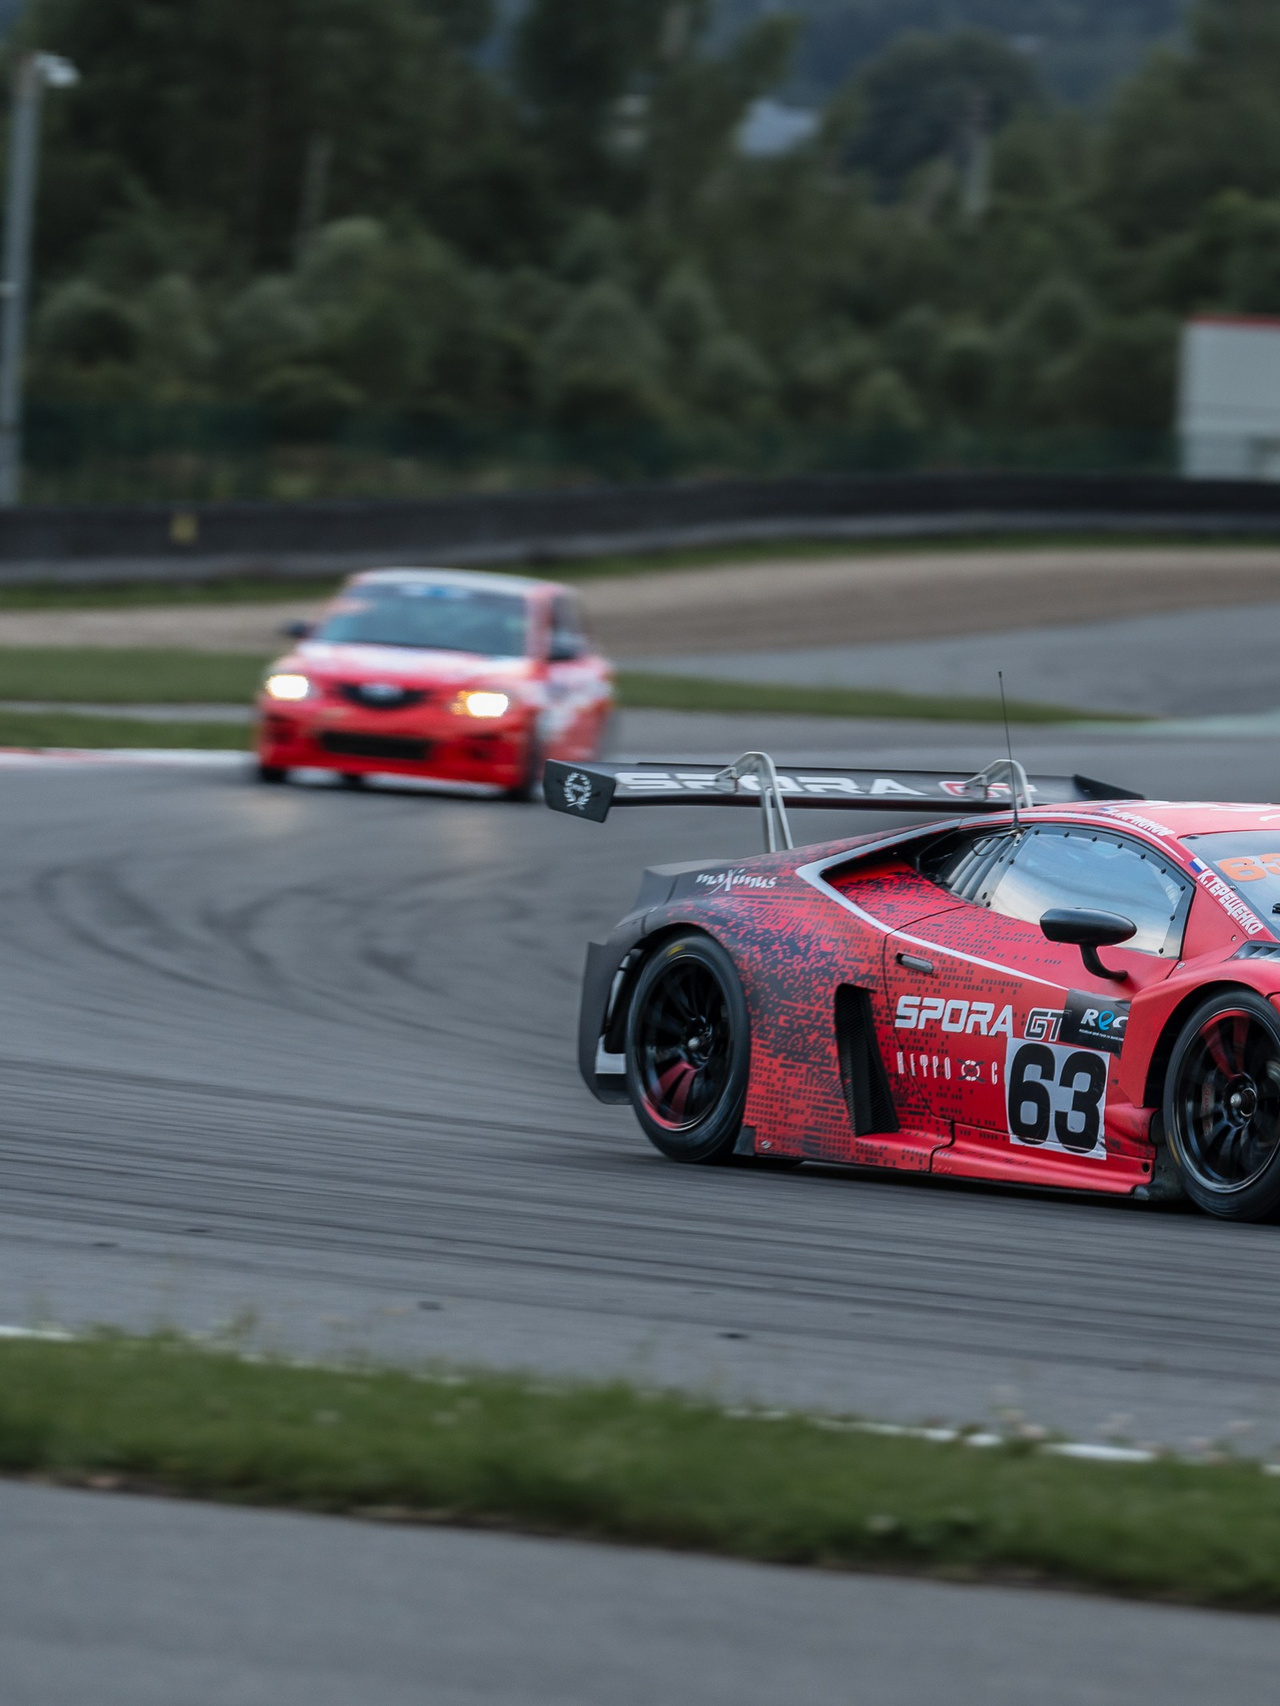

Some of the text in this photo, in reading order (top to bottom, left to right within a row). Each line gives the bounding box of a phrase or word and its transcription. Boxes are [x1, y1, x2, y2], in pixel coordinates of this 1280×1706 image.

[1196, 868, 1264, 935] К.ТЕРЕЩЕНКО
[894, 995, 1014, 1037] SPORA
[1023, 1007, 1072, 1042] GT
[1008, 1042, 1107, 1154] 63
